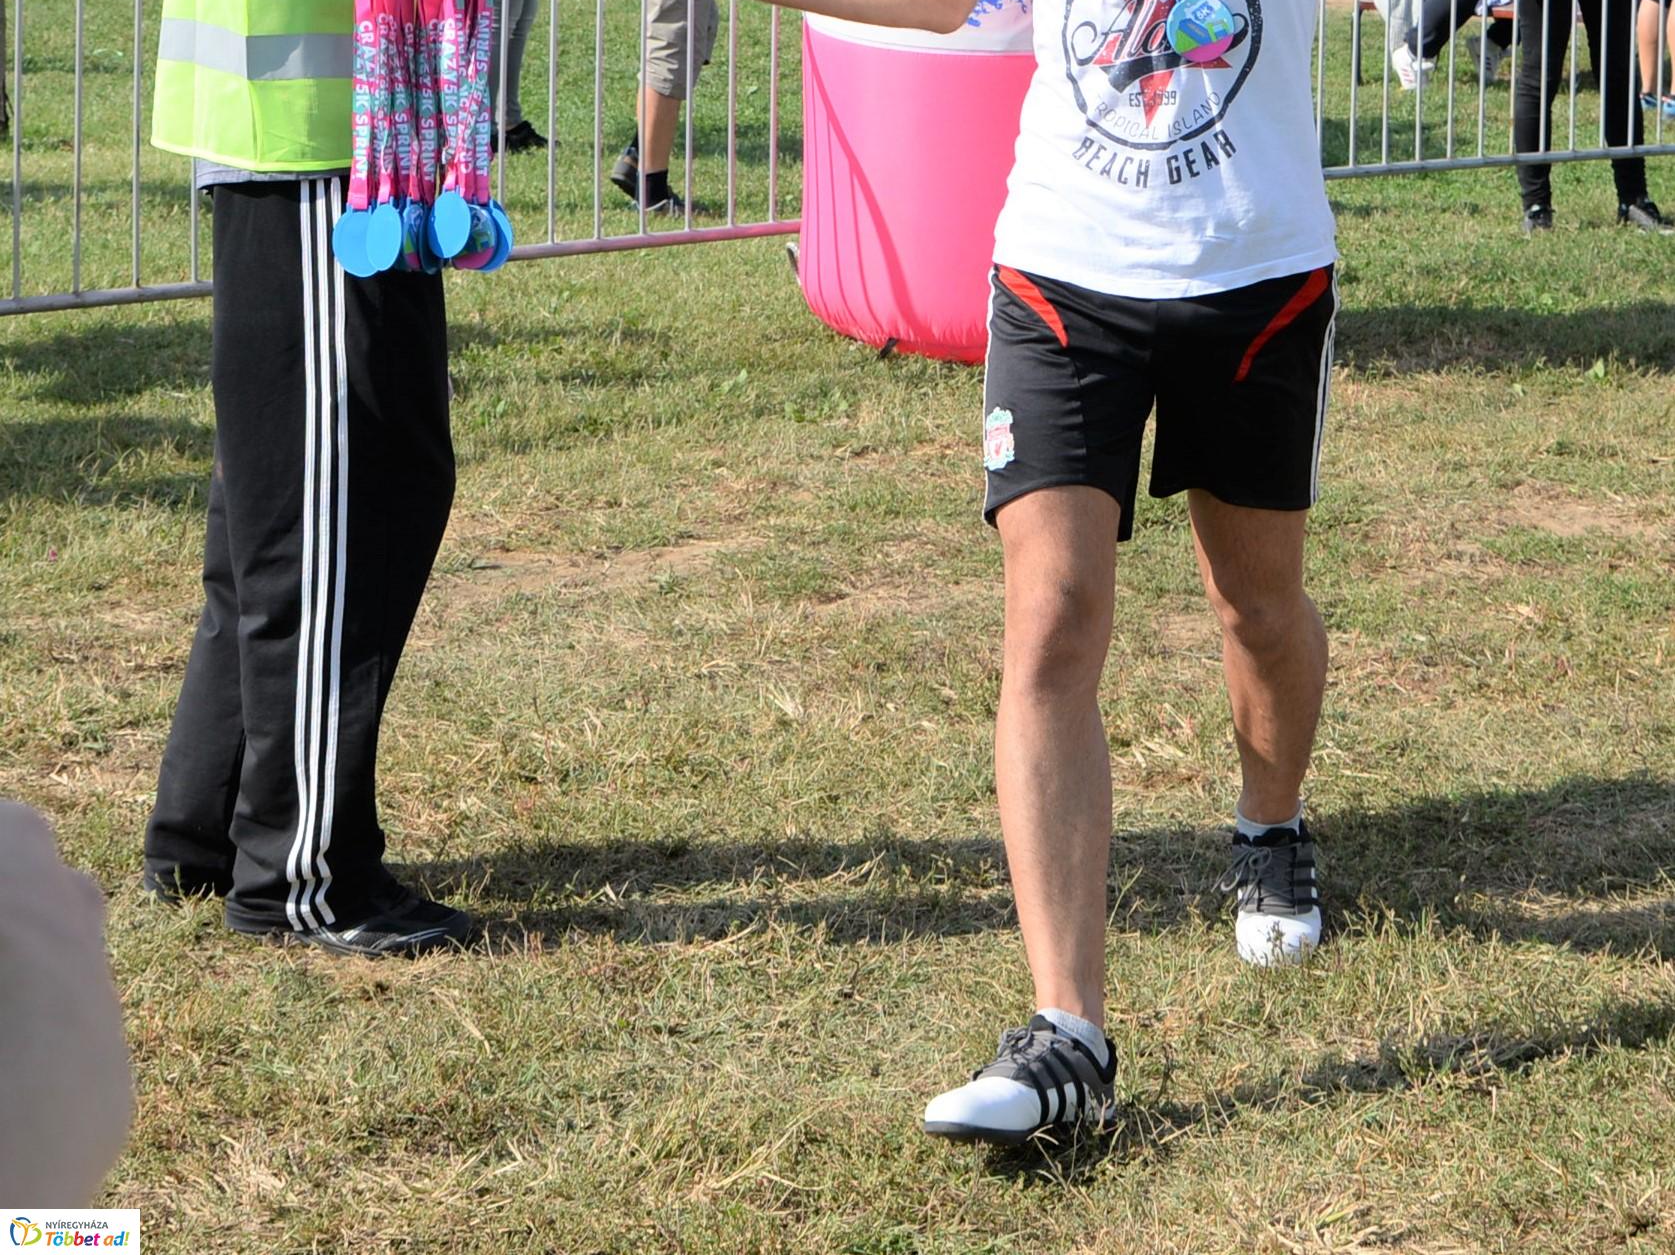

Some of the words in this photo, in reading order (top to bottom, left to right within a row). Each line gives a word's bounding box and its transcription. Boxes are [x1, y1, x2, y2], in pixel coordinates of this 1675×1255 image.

[395, 112, 411, 176] SPRINT
[475, 111, 489, 177] SPRINT
[1167, 90, 1222, 138] ISLAND
[353, 114, 370, 182] SPRINT
[421, 118, 436, 183] SPRINT
[1071, 135, 1151, 189] BEACH
[1166, 128, 1238, 185] GEAR
